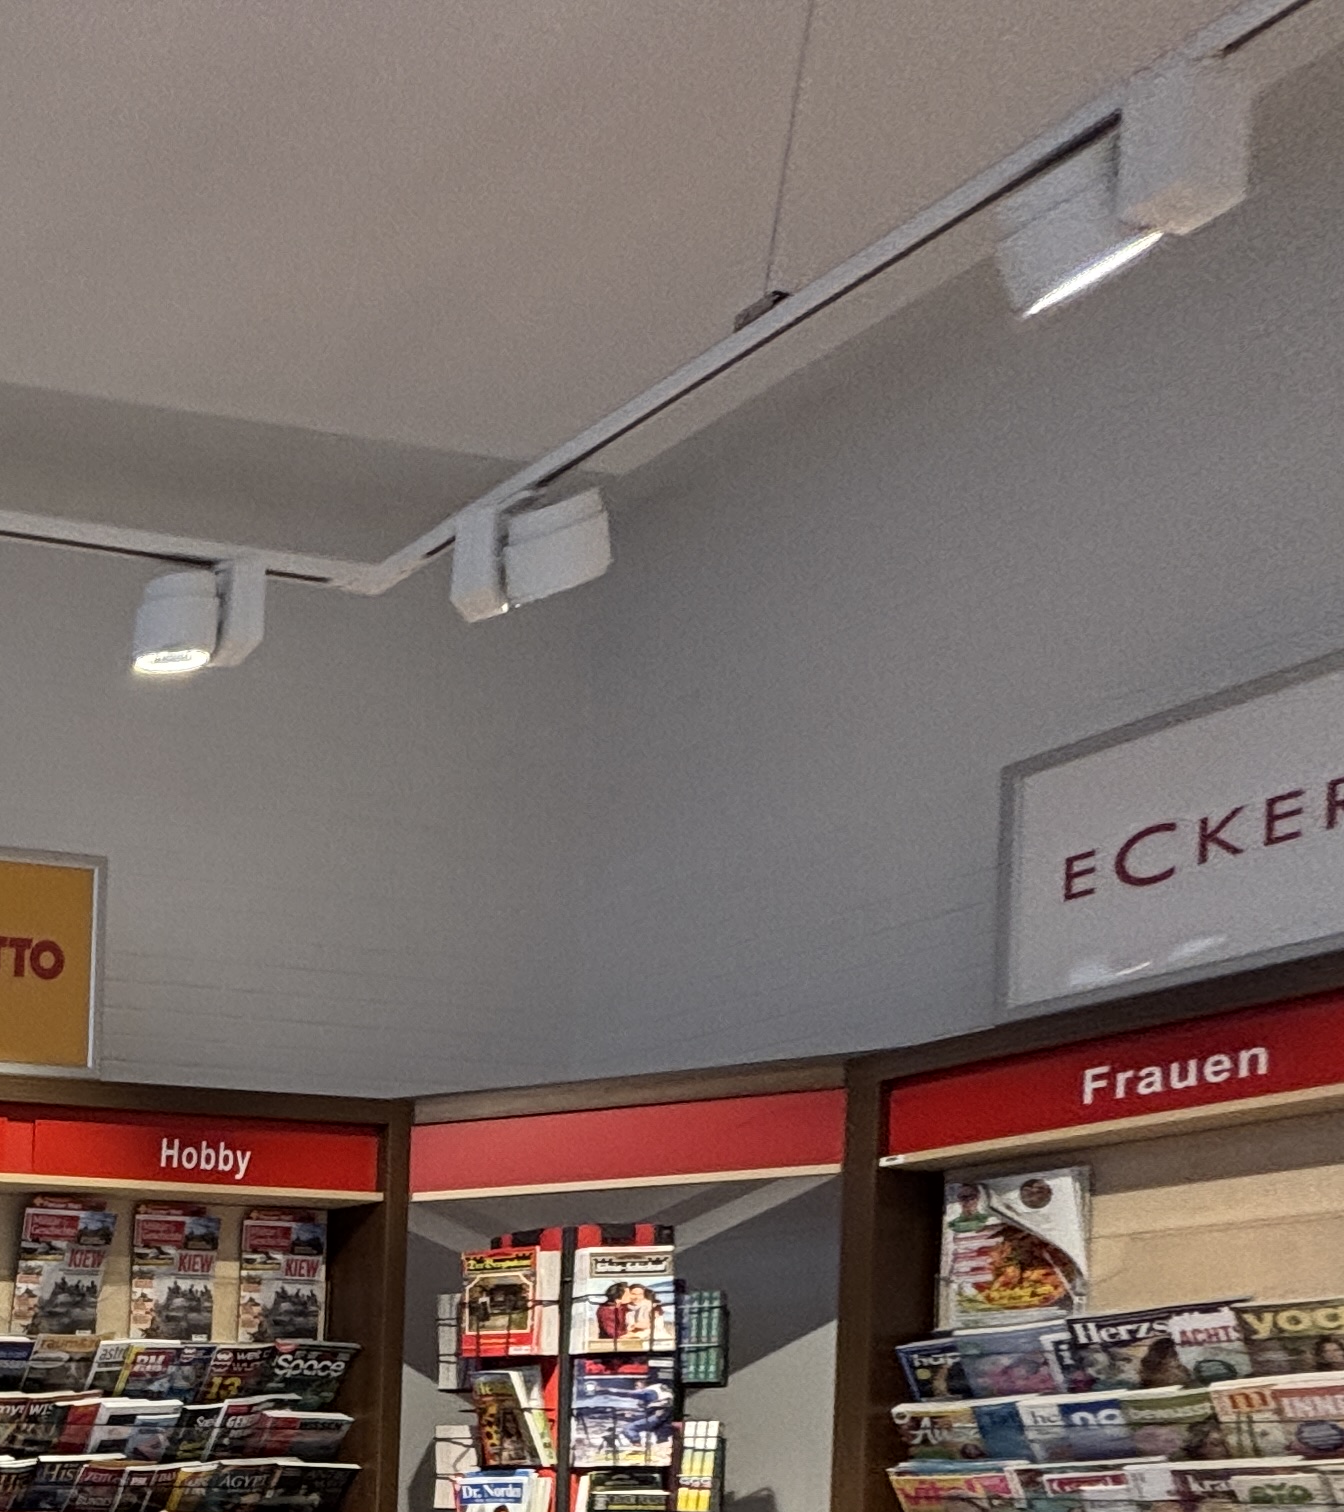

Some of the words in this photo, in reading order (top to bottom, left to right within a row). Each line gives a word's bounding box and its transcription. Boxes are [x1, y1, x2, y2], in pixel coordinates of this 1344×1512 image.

[1083, 1046, 1269, 1104] Frauen
[158, 1137, 253, 1181] Hobby
[69, 1248, 106, 1269] KIEW
[177, 1253, 213, 1273] KIEW
[284, 1257, 321, 1277] KIEW
